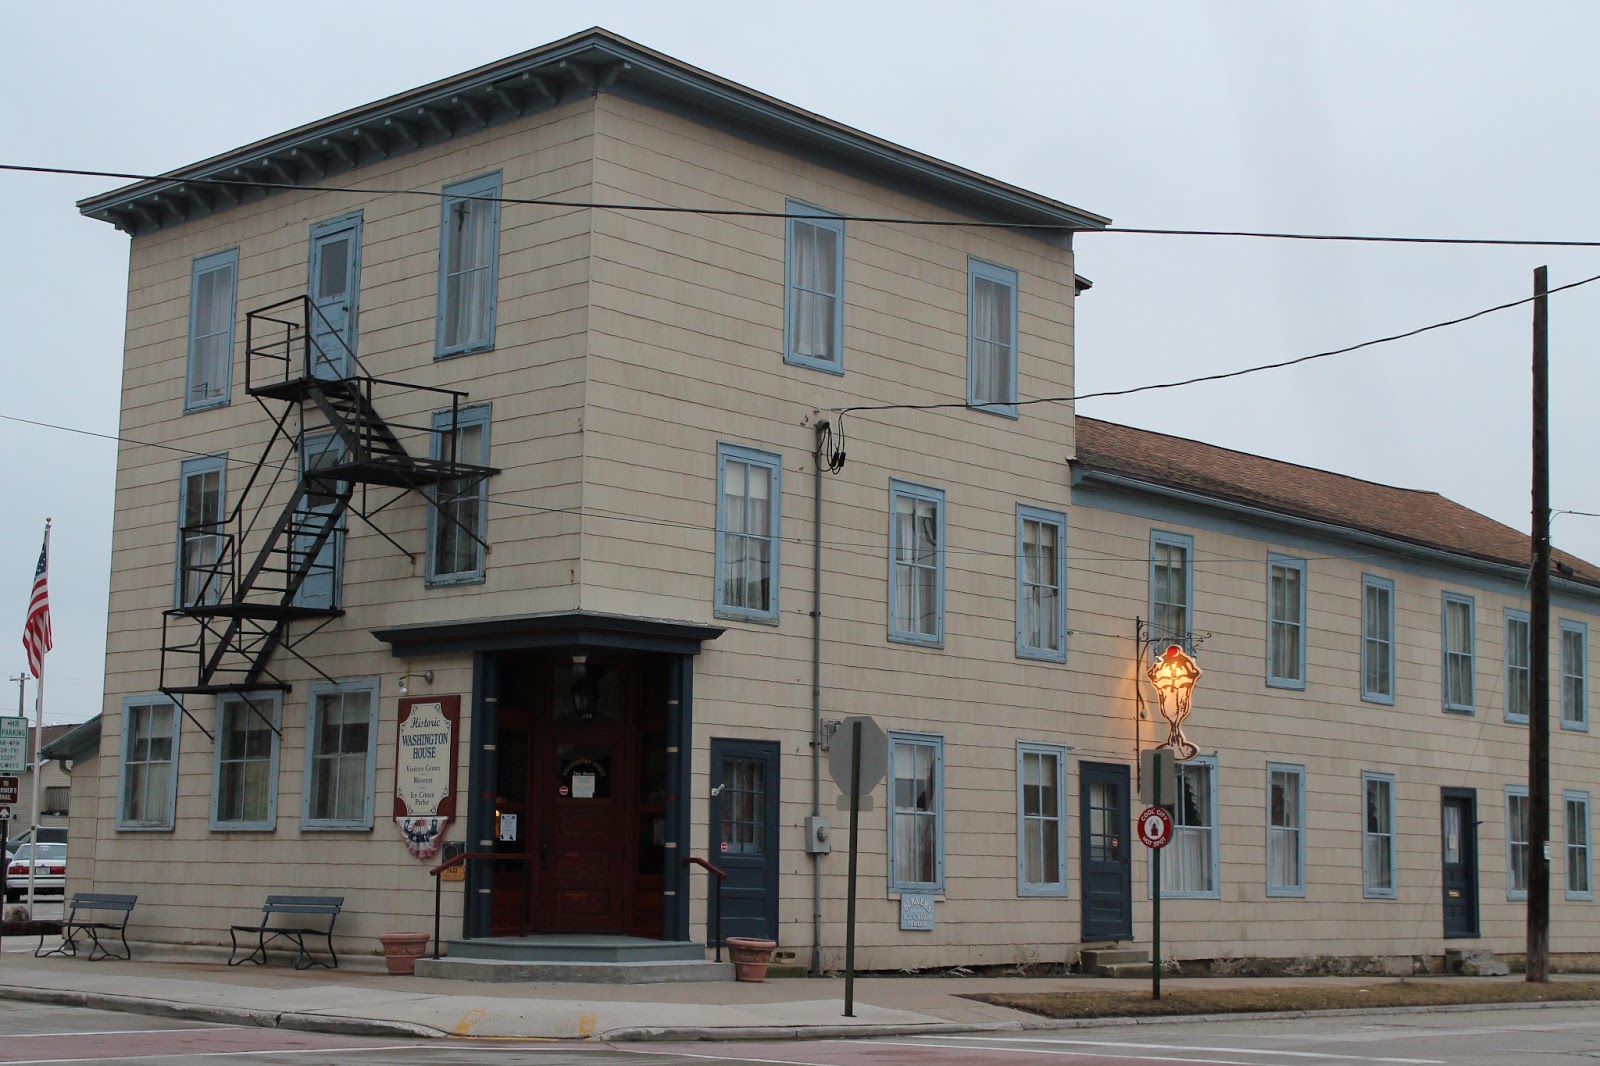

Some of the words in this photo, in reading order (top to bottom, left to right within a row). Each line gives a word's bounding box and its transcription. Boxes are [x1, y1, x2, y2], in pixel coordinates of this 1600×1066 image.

[410, 717, 441, 729] Historic
[1, 728, 26, 736] PARKING
[402, 733, 448, 746] WASHINGTON
[413, 746, 437, 759] HOUSE
[415, 798, 430, 806] Parlor
[1156, 809, 1168, 821] CITY
[1142, 836, 1152, 846] HOT
[1153, 836, 1166, 848] SPOT
